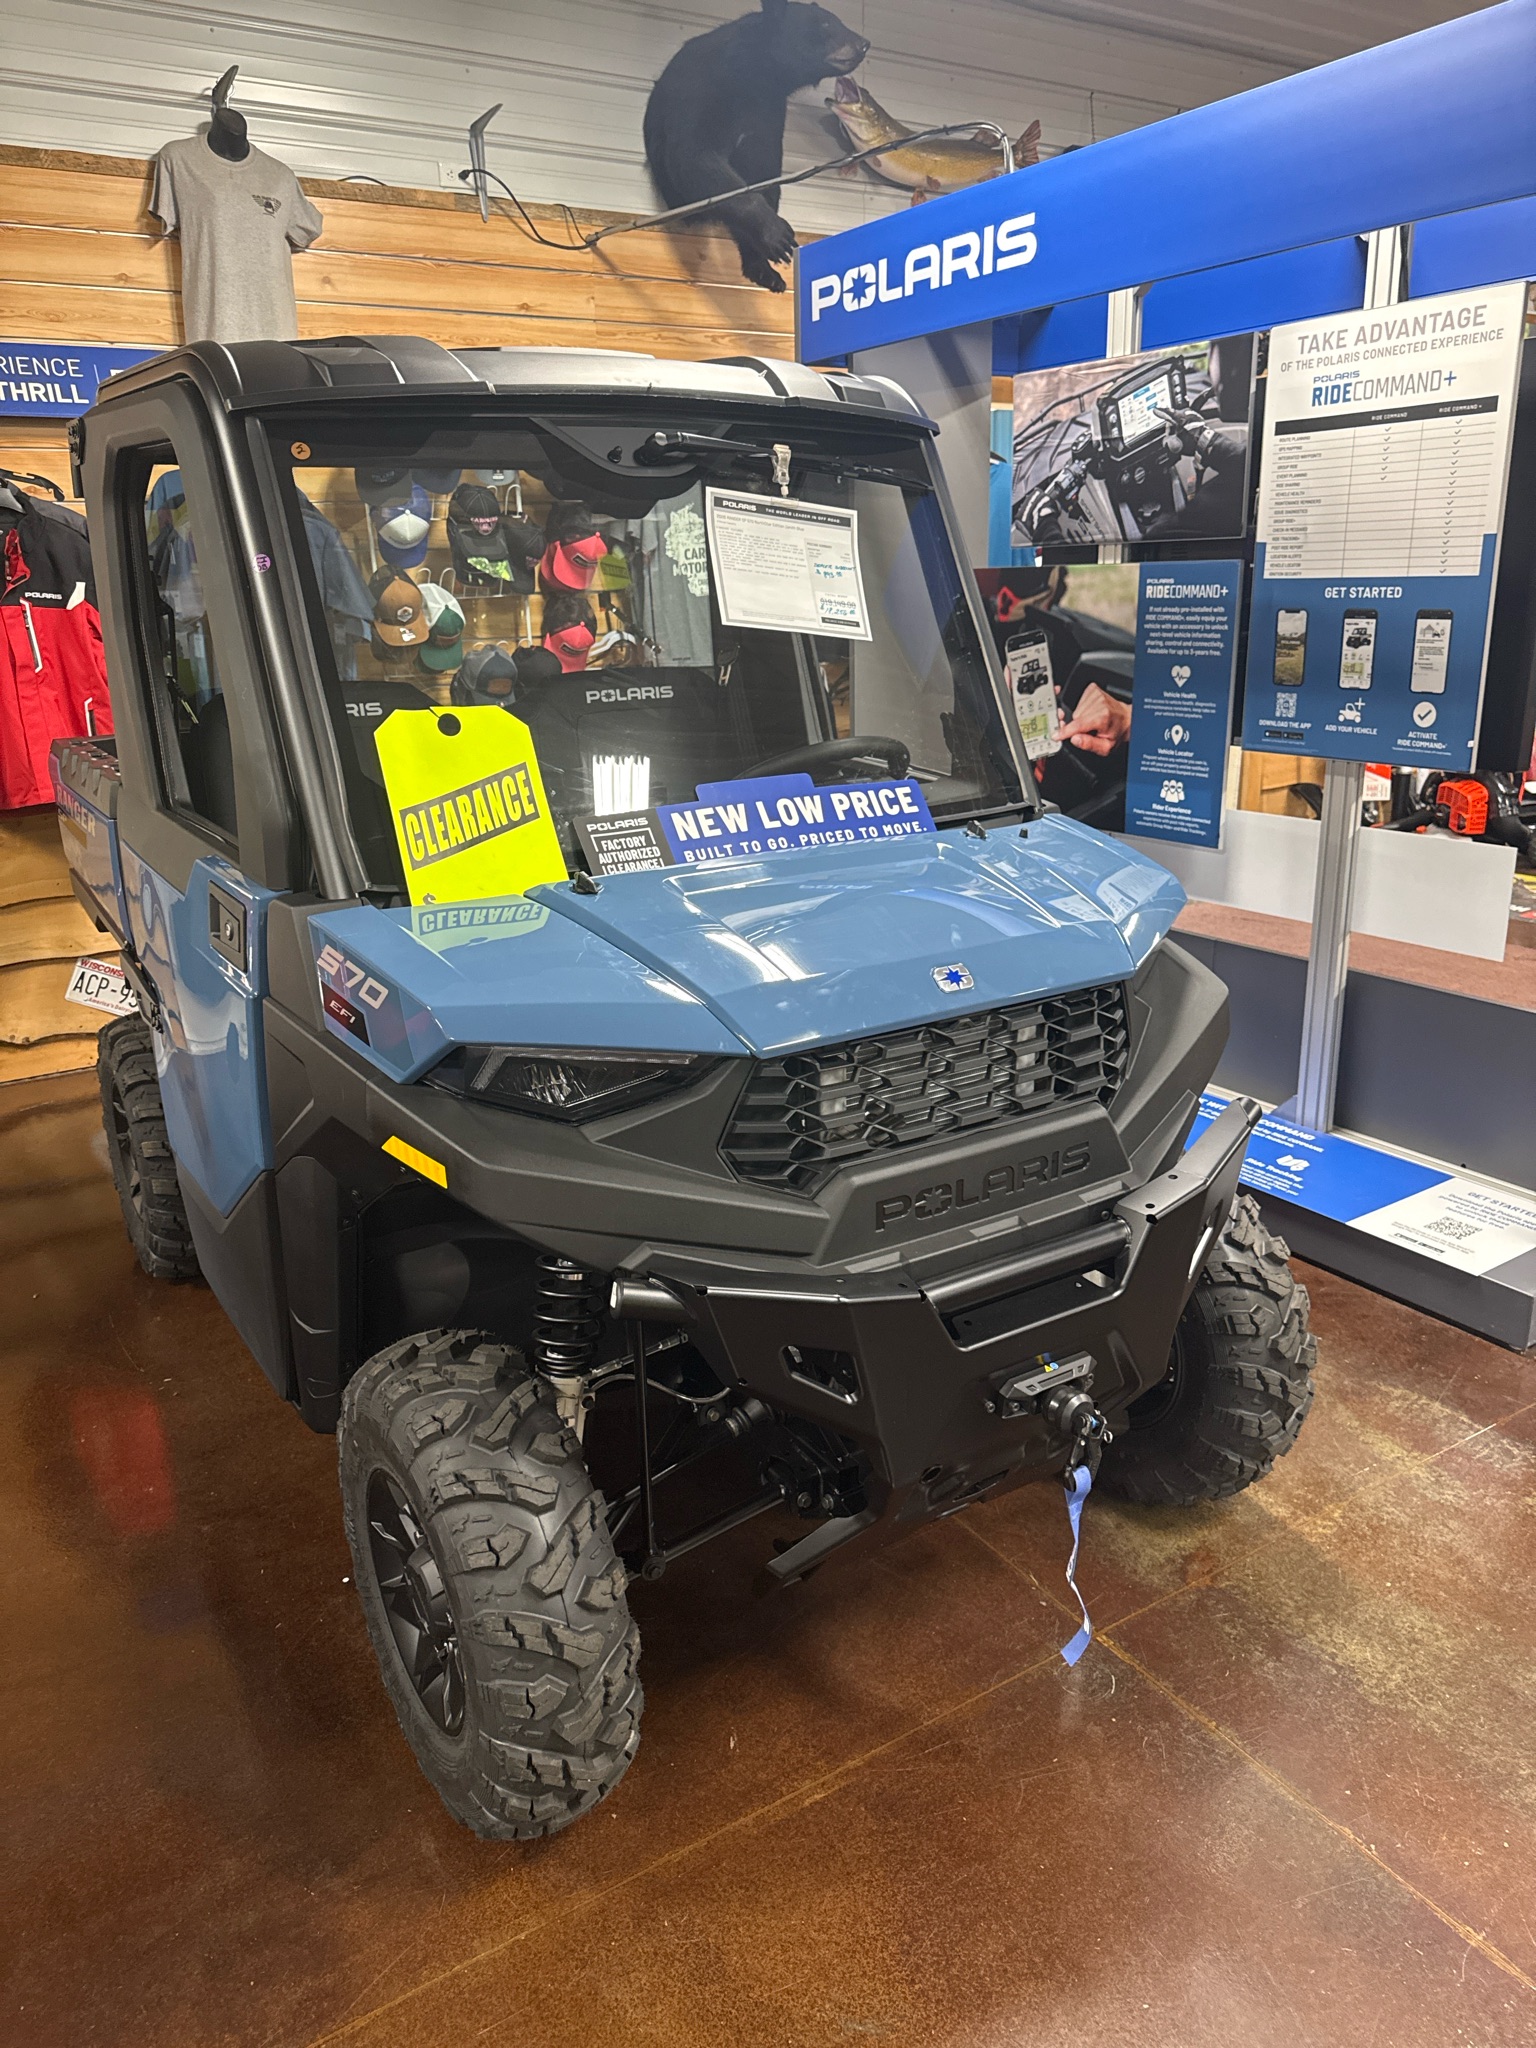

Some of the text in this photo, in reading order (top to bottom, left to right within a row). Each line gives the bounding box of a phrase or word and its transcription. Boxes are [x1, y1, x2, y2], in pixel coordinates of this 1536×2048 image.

[811, 212, 1038, 322] POLARIS
[1298, 305, 1487, 355] TAKE ADVANTAGE
[1281, 328, 1504, 372] OF THE POLARIS CONNECTED EXPERIENCE
[1313, 370, 1360, 384] POLARIS
[0, 381, 89, 404] THRILL
[722, 500, 757, 511] POLARIS
[24, 592, 62, 600] POLARIS
[1324, 586, 1402, 599] GET STARTED
[586, 685, 674, 704] POLARIS
[1259, 719, 1312, 730] DOWNLOAD THE APP
[1339, 725, 1352, 733] YOUR
[1353, 727, 1377, 735] VEHICLE
[1397, 739, 1411, 747] RIDE
[1408, 731, 1438, 740] ACTIVATE
[403, 769, 536, 863] CLEARANCE
[670, 786, 919, 842] NEW LOW PRICE
[1165, 805, 1192, 815] Experience
[586, 817, 649, 832] POLARIS
[601, 835, 647, 851] FACTORY
[683, 820, 927, 863] BUILT TO GO. PRICED TO MOVE.
[599, 846, 661, 865] AUTHORIZED
[605, 859, 661, 875] CLEARANCE
[317, 944, 388, 1009] 570
[329, 1000, 355, 1024] EFI
[1245, 1157, 1303, 1181] Ride Tracking
[875, 1141, 1091, 1233] POLARIS
[1468, 1192, 1491, 1201] GET
